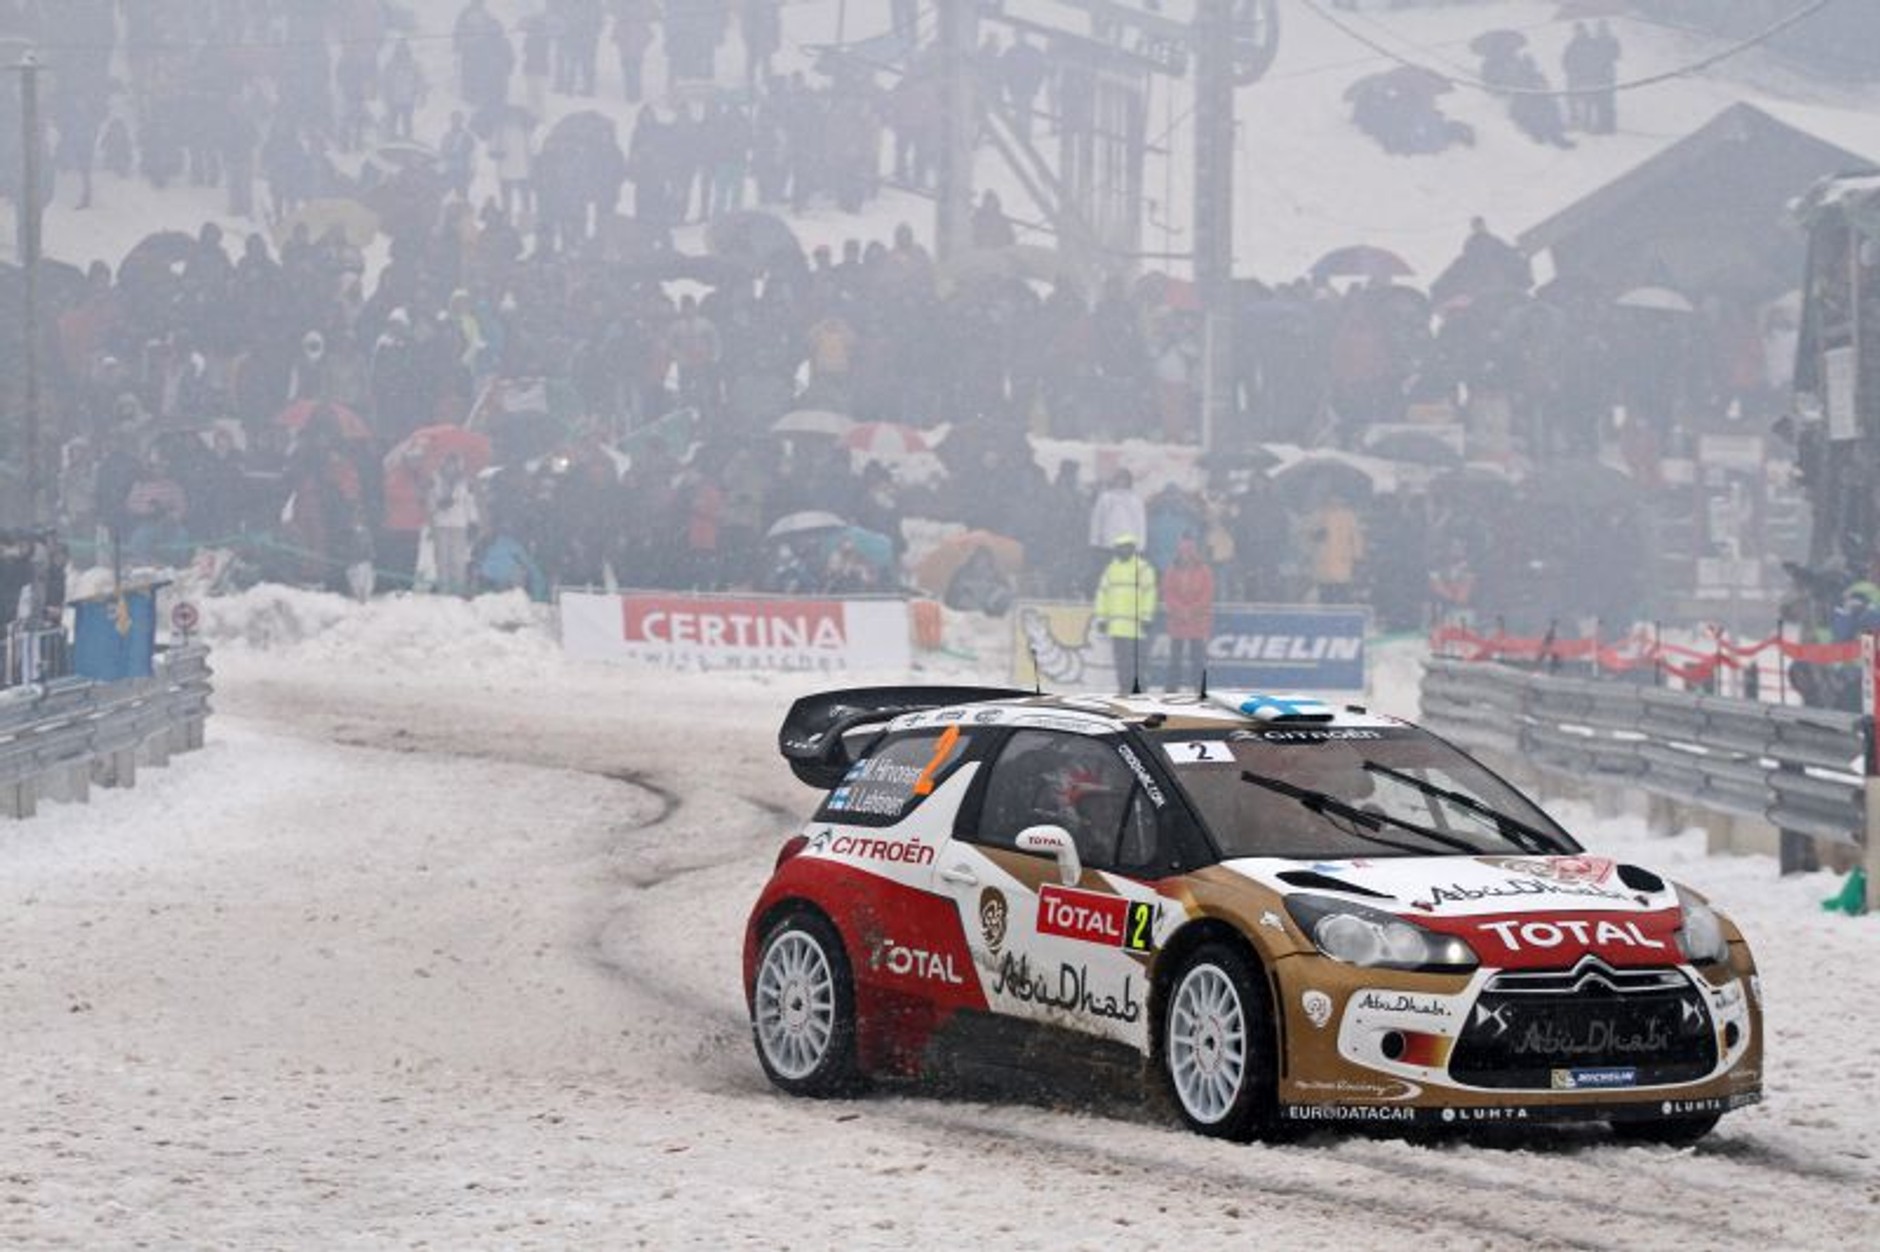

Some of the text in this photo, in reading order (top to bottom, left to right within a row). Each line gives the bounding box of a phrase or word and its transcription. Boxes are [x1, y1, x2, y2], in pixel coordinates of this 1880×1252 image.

[640, 609, 847, 649] CERTINA
[1188, 741, 1214, 760] 2
[1028, 836, 1065, 847] TOTAL
[1429, 882, 1508, 905] Abu
[1043, 896, 1149, 949] TOTAL 2
[1478, 920, 1664, 951] TOTAL
[869, 940, 963, 984] TOTAL
[993, 951, 1056, 1004] Abu
[1359, 993, 1393, 1011] Abu
[1514, 1020, 1669, 1054] Abu Dhabi
[1576, 1070, 1634, 1082] MICHELIN
[1289, 1105, 1415, 1120] EURODATACAR
[1460, 1108, 1528, 1120] LUHTA
[1675, 1100, 1721, 1113] LUHTA
